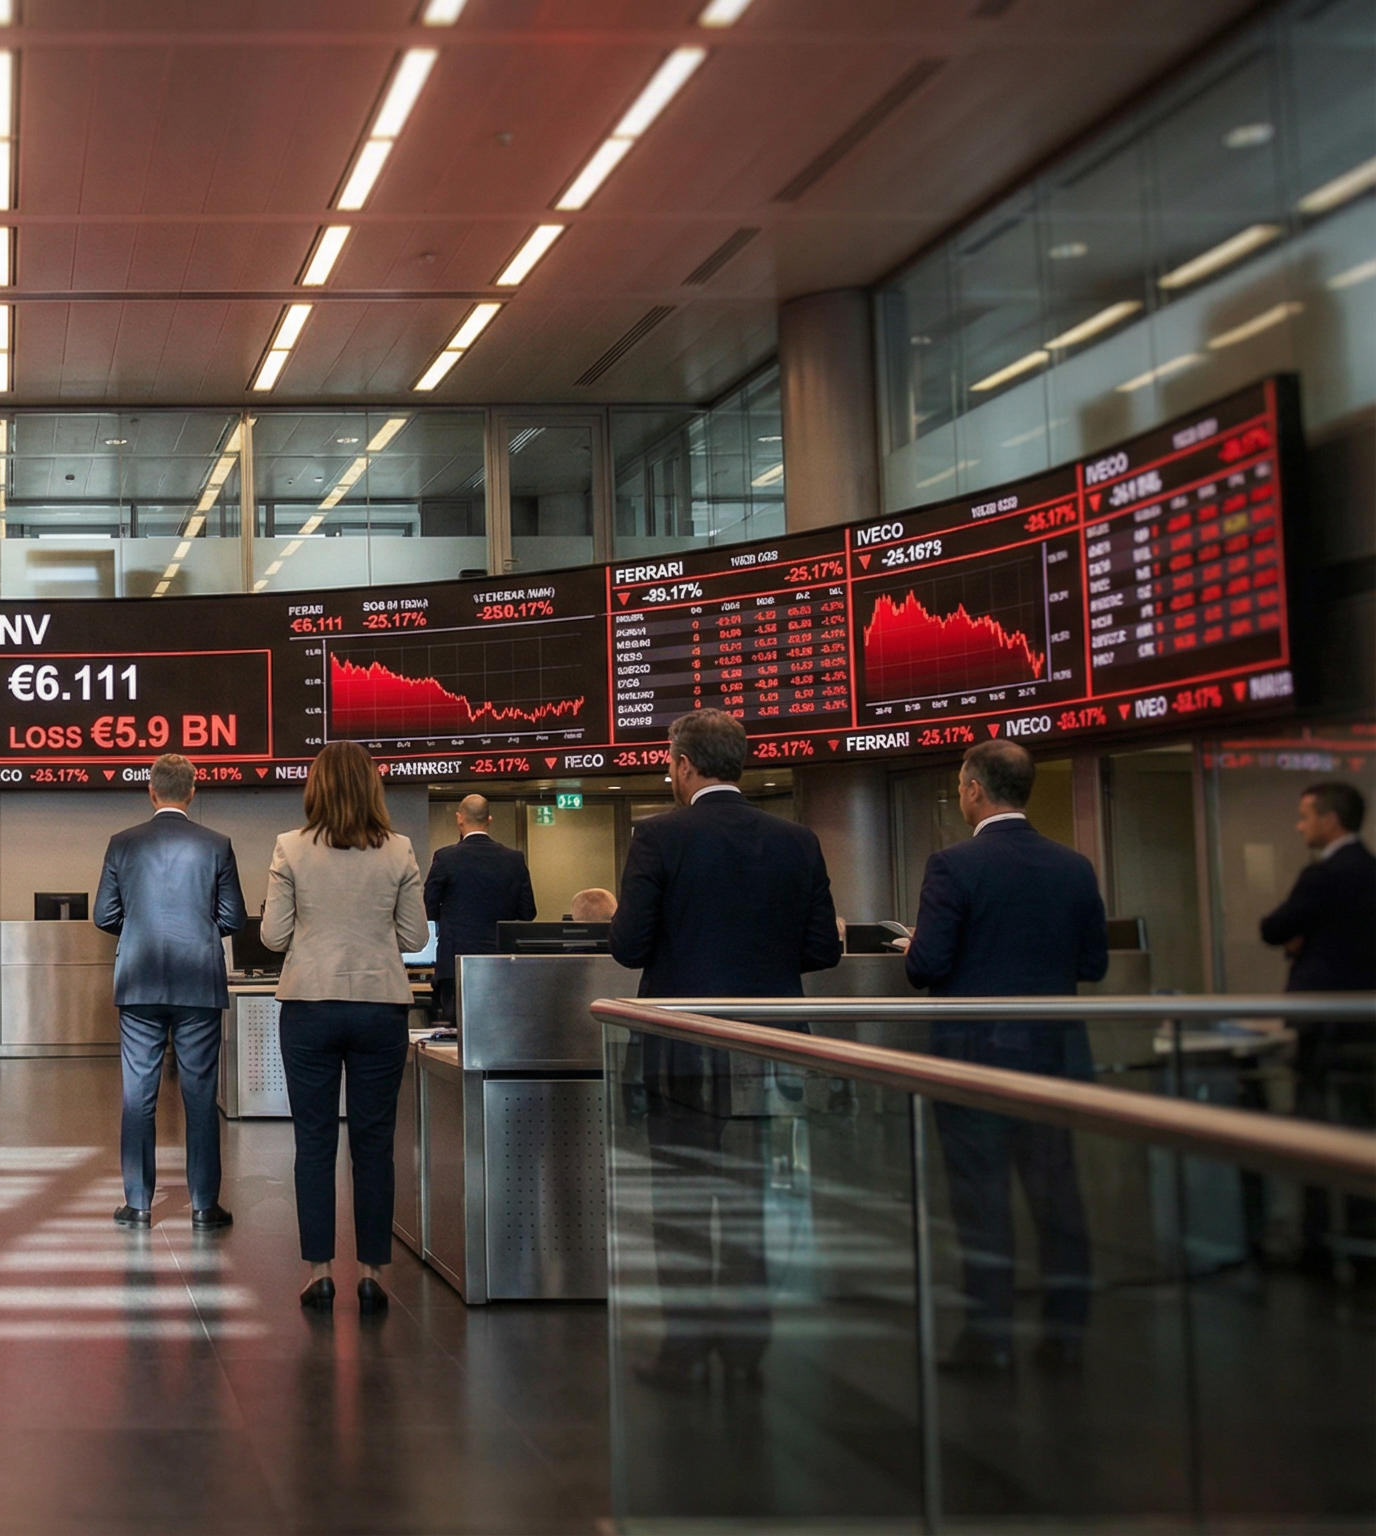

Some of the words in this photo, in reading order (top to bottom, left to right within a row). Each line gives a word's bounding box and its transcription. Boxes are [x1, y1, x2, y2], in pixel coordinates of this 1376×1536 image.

[1024, 502, 1076, 532] -25.17%
[857, 522, 904, 546] IVECO
[615, 561, 683, 584] FERRARI
[784, 560, 843, 582] -25.17%
[362, 612, 427, 629] -25.17%
[8, 664, 138, 701] €6.111
[9, 726, 82, 749] LOSS
[90, 715, 170, 748] €5.9
[182, 714, 237, 747] BN
[917, 725, 974, 747] -25.17%
[1006, 715, 1051, 738] IVECO
[753, 739, 814, 759] -25.17%
[30, 768, 89, 782] -25.17%
[470, 757, 530, 774] -25.17%
